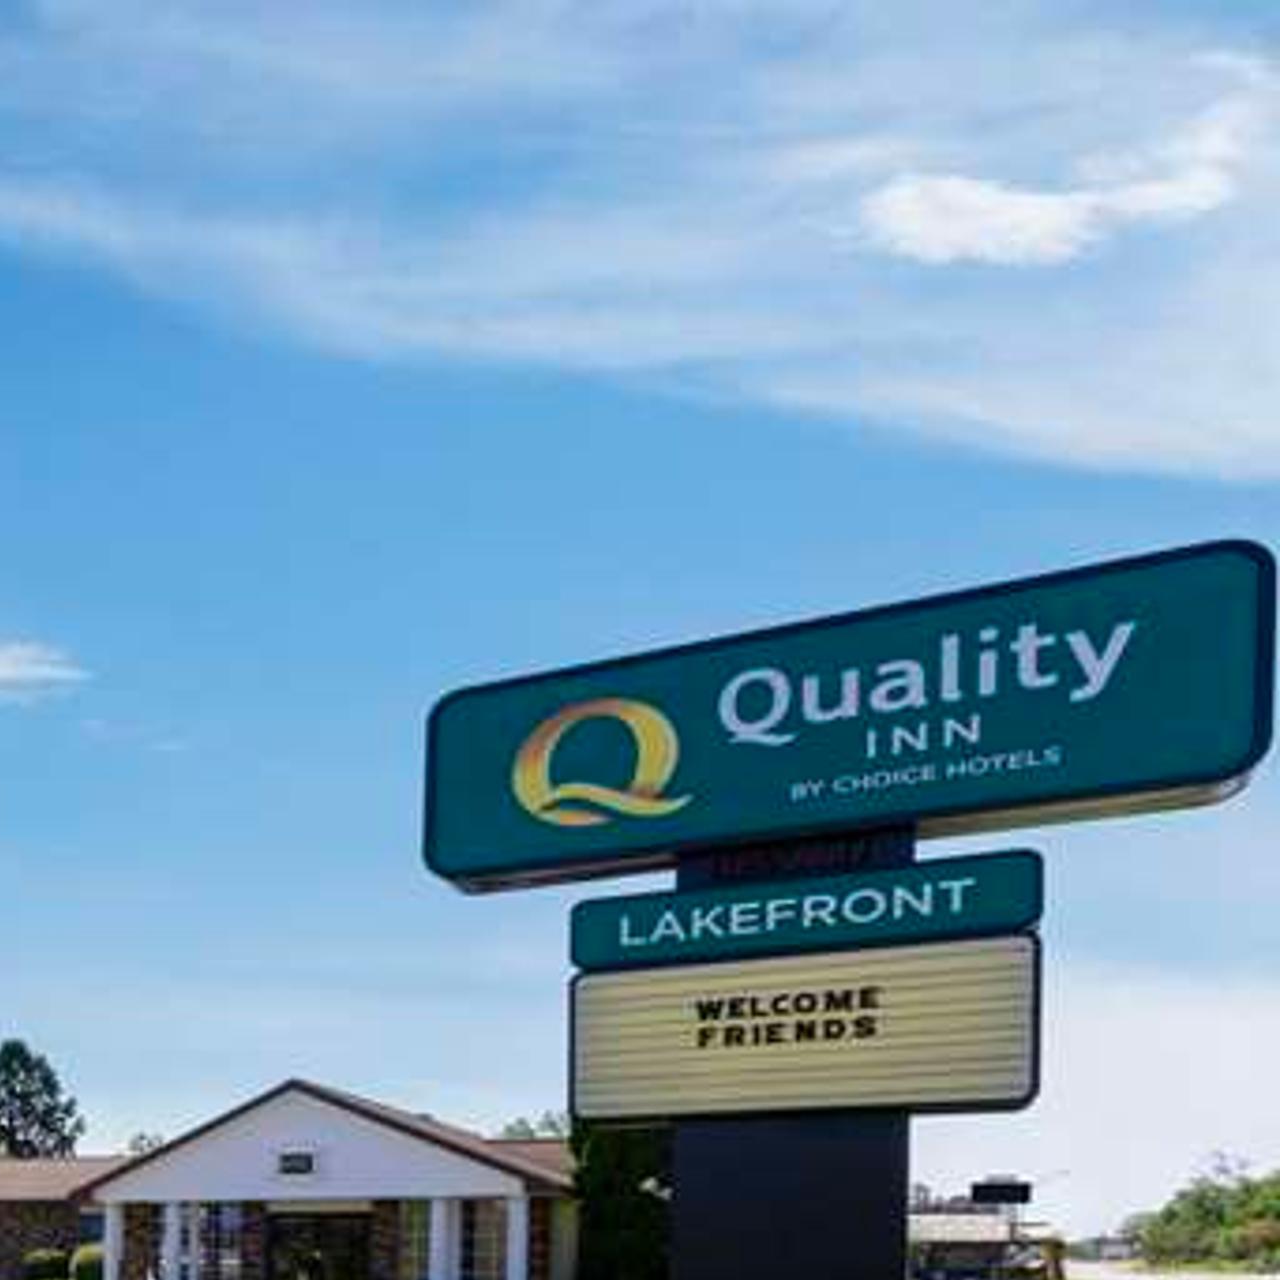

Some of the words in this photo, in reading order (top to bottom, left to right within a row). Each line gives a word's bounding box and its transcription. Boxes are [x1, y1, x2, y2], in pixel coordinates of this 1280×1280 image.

[718, 621, 1136, 746] Quality
[512, 697, 693, 826] Q
[866, 712, 982, 758] INN
[790, 778, 826, 801] BY
[833, 763, 937, 793] CHOICE
[946, 745, 1062, 779] HOTELS
[619, 877, 975, 946] LAKEFRONT
[695, 986, 882, 1021] WELCOME
[696, 1015, 877, 1048] FRIENDS
